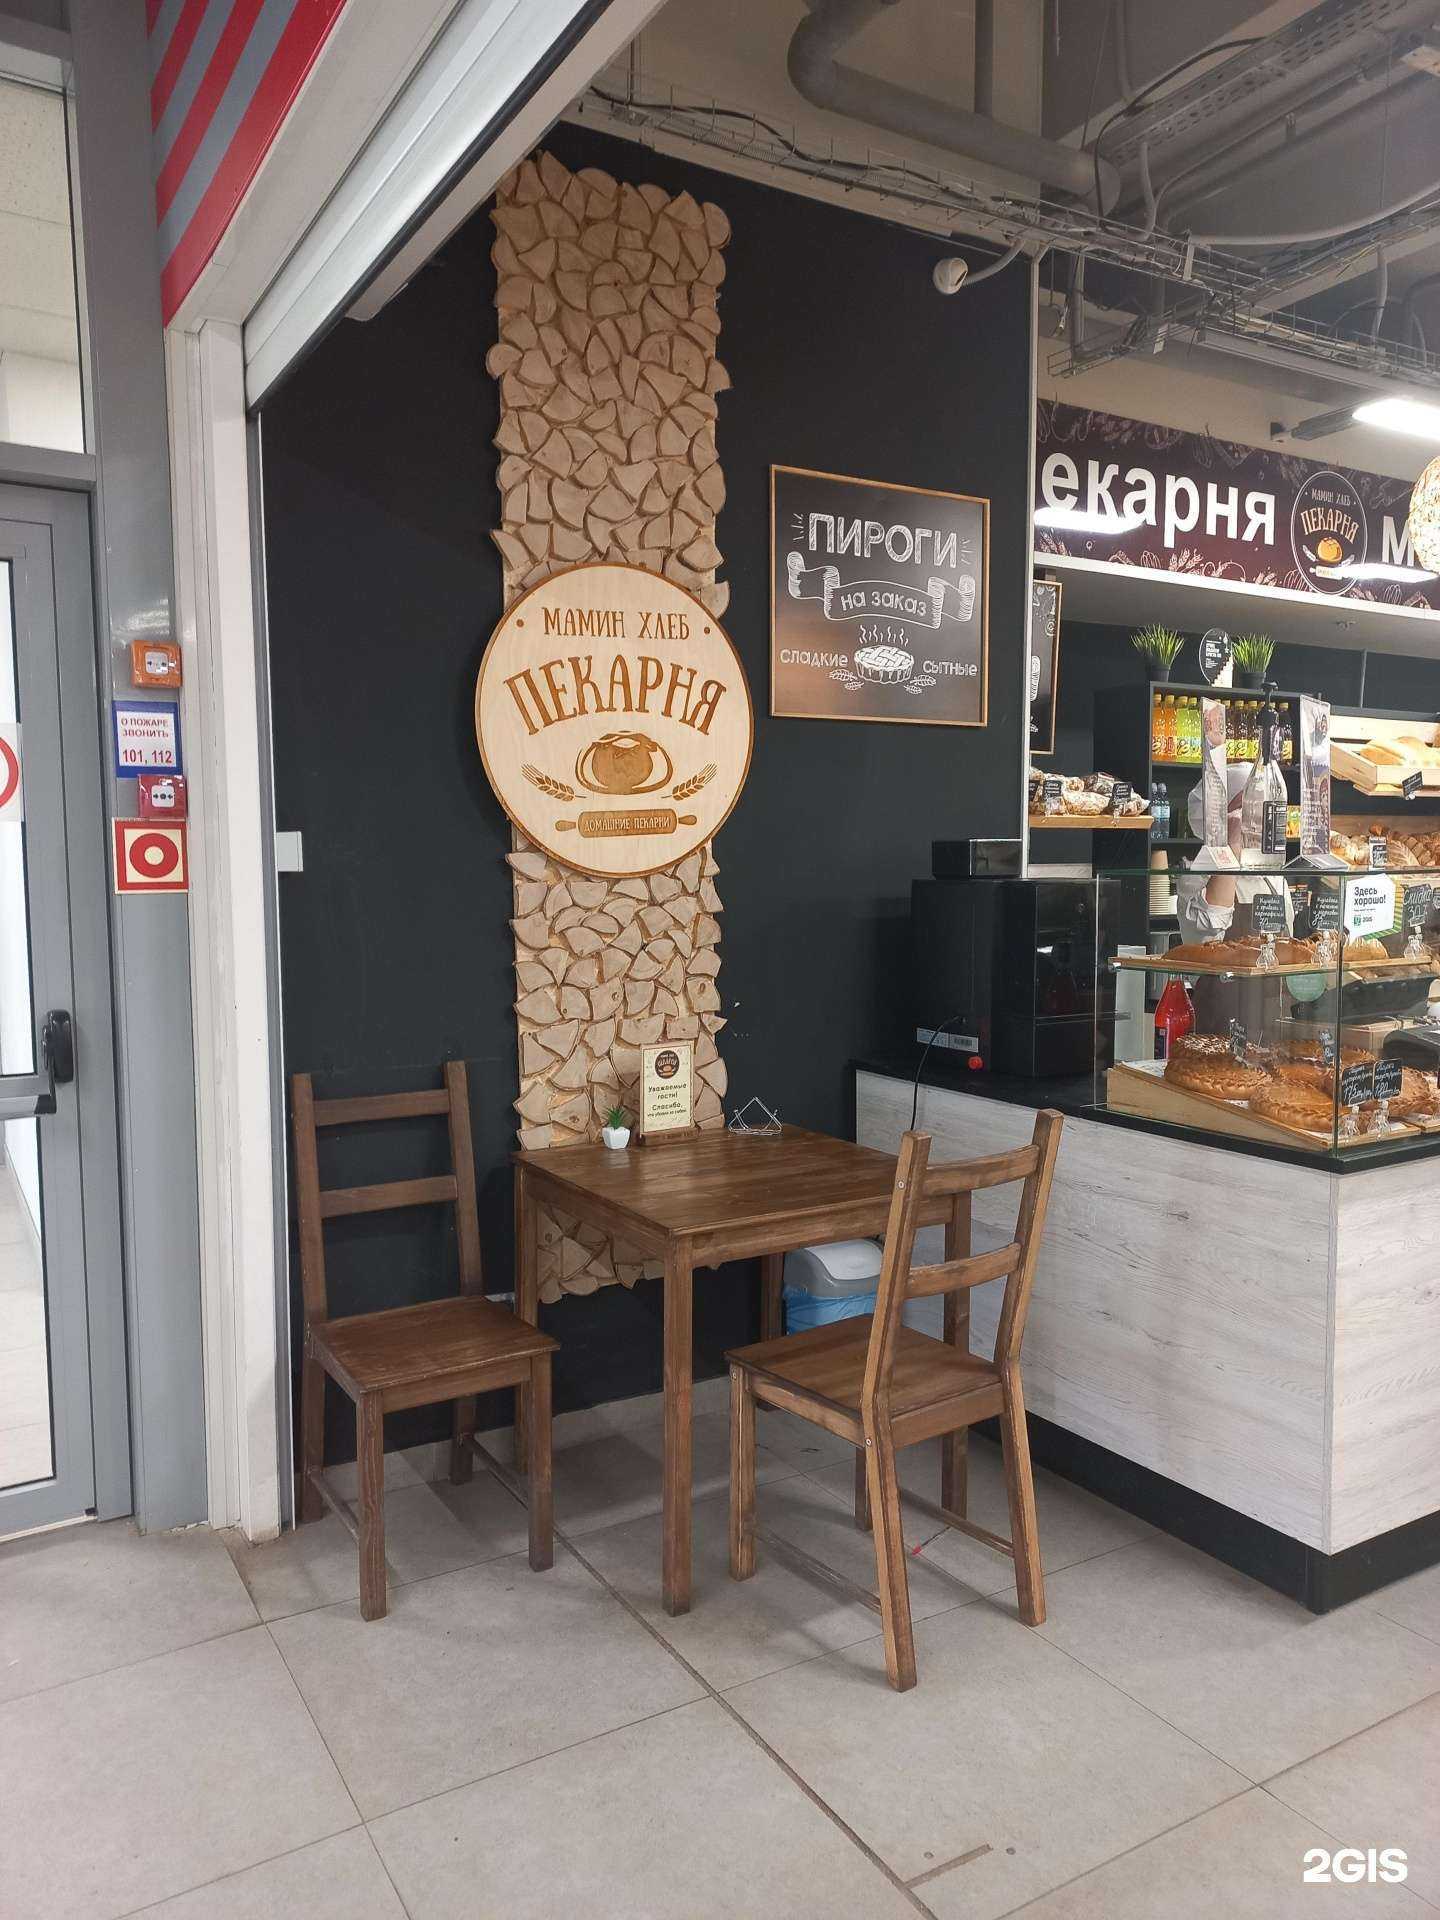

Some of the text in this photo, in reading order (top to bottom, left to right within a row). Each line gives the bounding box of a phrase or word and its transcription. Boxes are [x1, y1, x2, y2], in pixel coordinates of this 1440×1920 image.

[1300, 507, 1360, 545] ПЕКАРНЯ
[808, 512, 957, 568] ПИРОГИ
[840, 591, 927, 616] на заказ
[541, 606, 690, 640] МАМИН ХЛЕБ
[503, 654, 728, 736] ПЕКАРНЯ
[121, 717, 169, 727] О ПОЖАРЕ
[122, 729, 169, 738] ЗВОНИТЬ
[122, 749, 173, 765] 101, 112
[584, 816, 671, 833] ДОМАШНИЕ ПЕКАРНИ
[1354, 886, 1378, 897] Здесь
[1353, 894, 1387, 907] хорошо!
